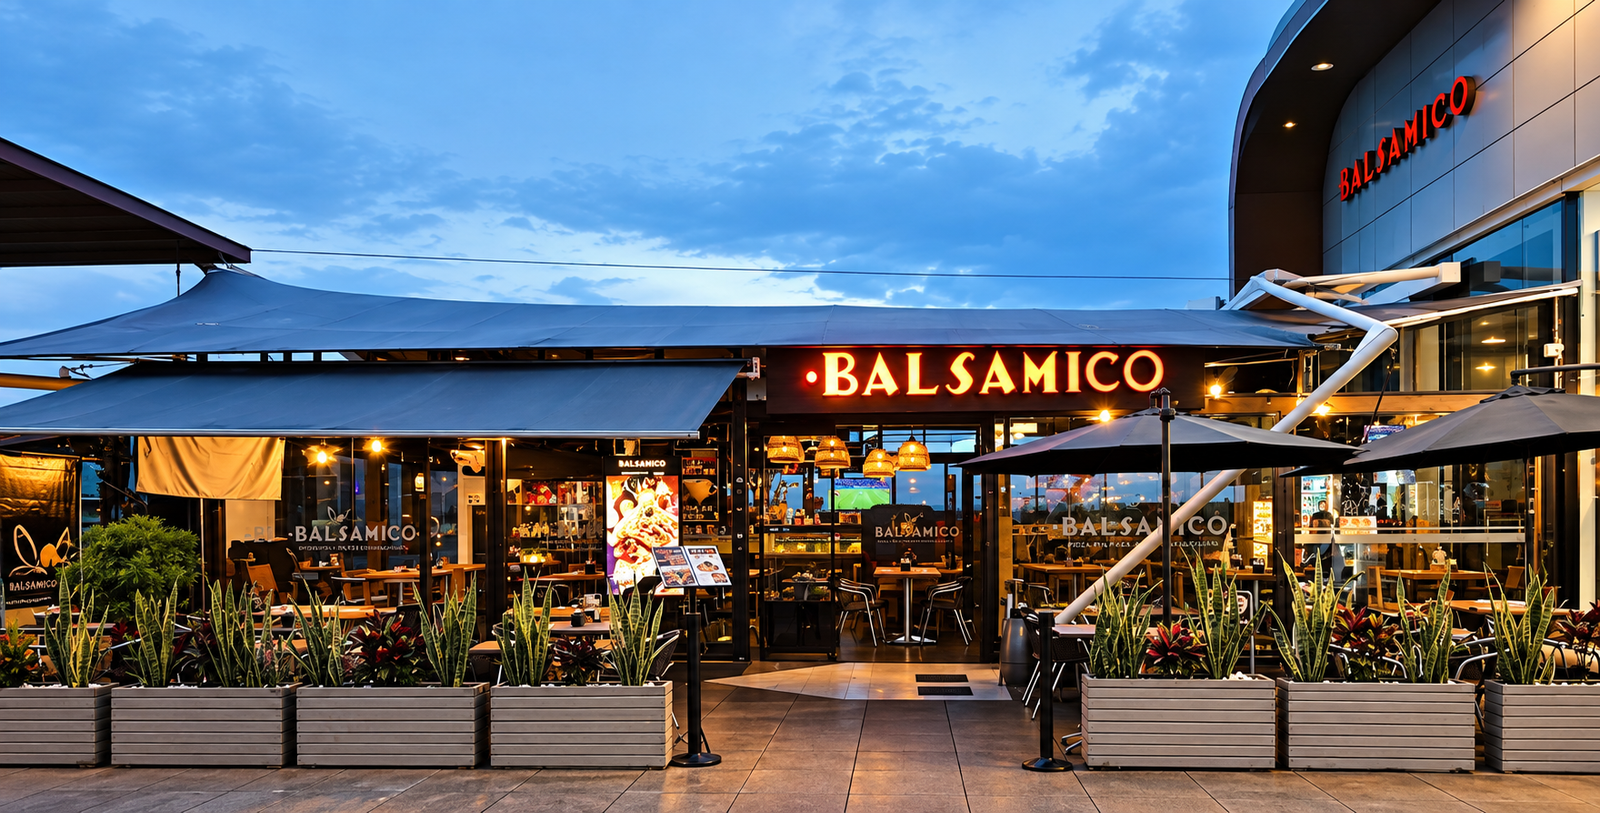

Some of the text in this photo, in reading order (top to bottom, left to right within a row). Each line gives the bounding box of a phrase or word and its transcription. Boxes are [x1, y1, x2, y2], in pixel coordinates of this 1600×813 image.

[1340, 76, 1470, 201] BALSAMICO
[822, 350, 1164, 396] BALSAMICO
[618, 459, 666, 468] BALSAMICO
[295, 525, 416, 542] BALSAMICO
[9, 579, 58, 591] BALSAMICO
